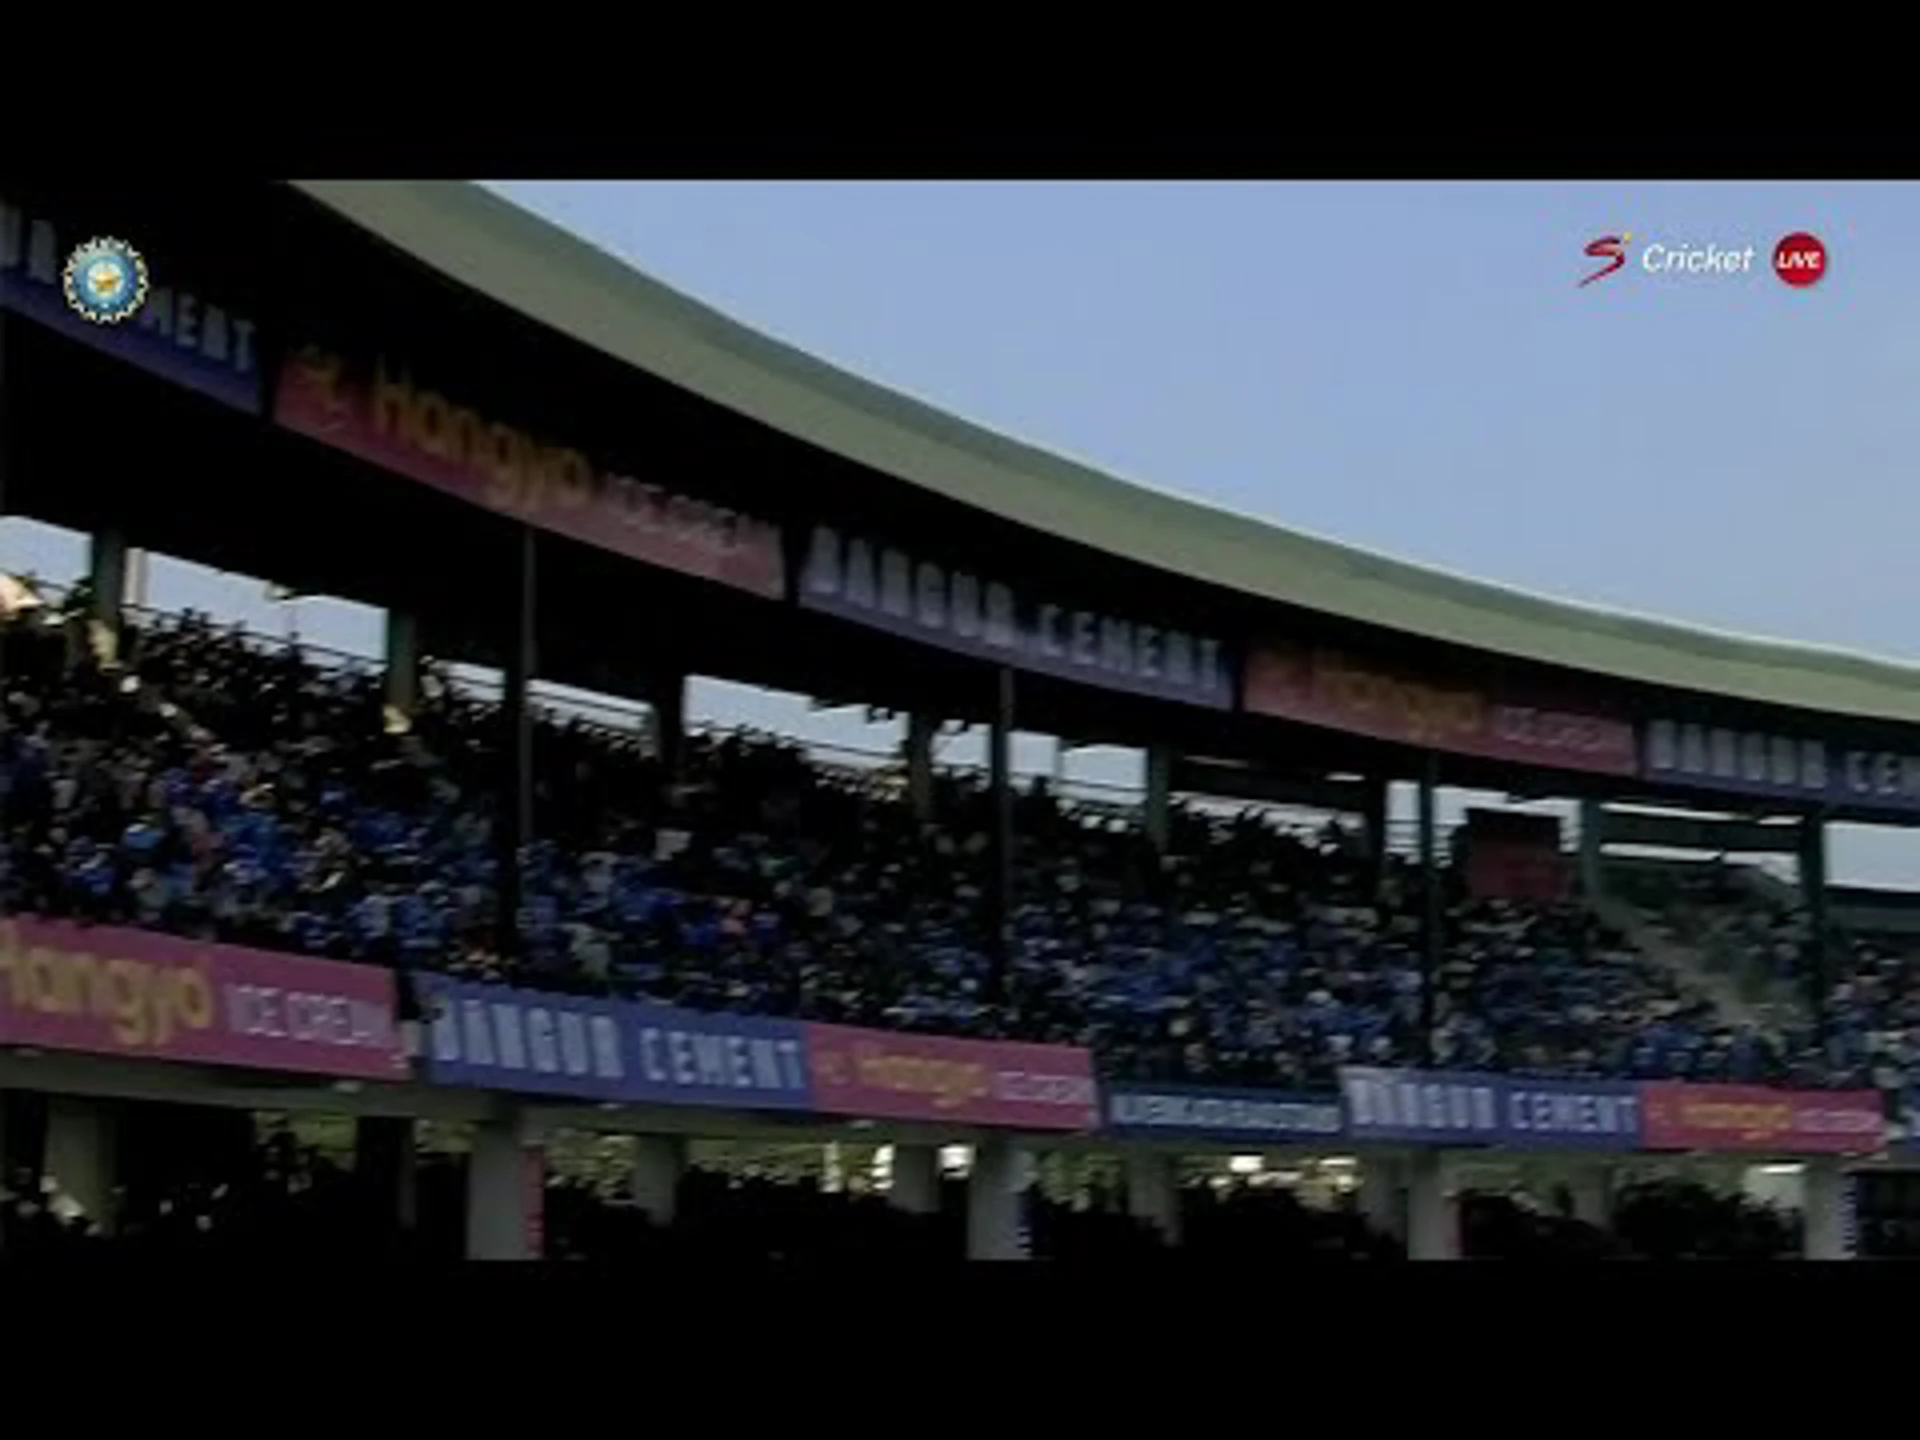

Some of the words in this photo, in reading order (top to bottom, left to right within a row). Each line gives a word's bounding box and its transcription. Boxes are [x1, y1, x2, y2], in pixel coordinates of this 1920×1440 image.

[1034, 601, 1226, 691] CEMENT
[639, 1026, 806, 1090] CEMENT
[1511, 1090, 1639, 1135] CEMENT
